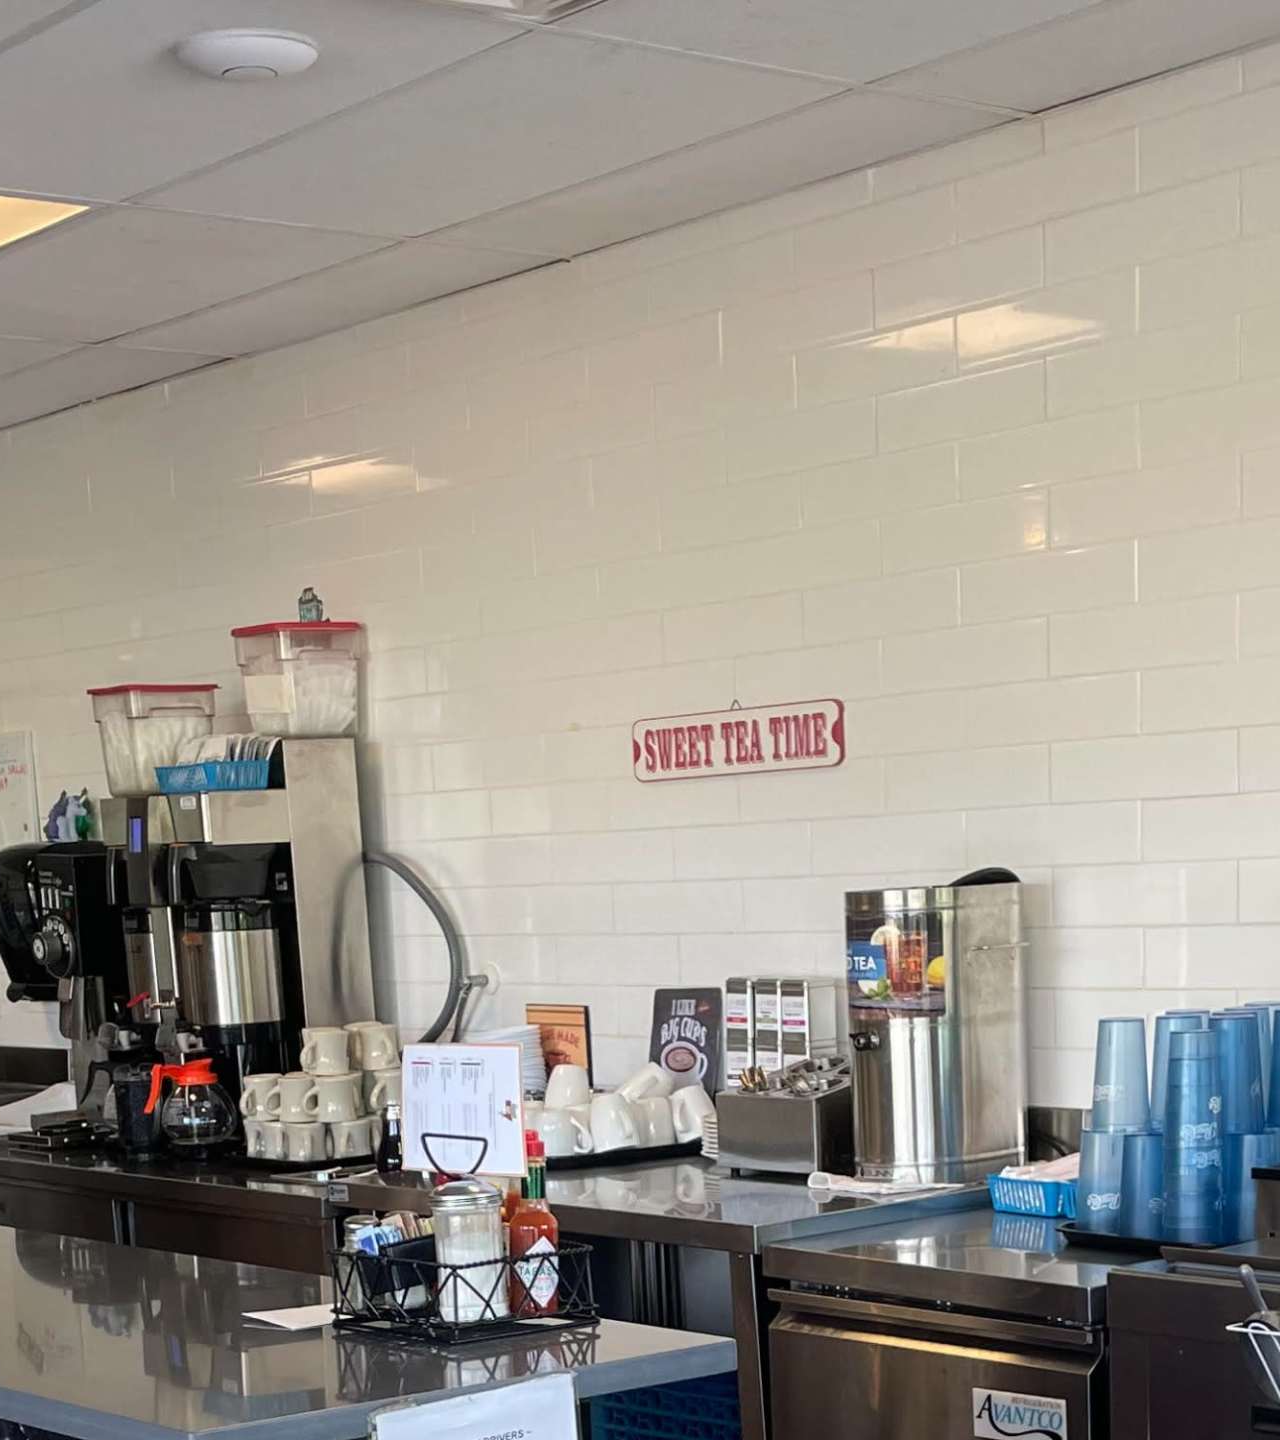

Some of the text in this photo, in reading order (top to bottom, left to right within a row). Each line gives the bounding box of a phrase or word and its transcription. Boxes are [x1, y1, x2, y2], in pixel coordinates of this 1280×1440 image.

[643, 711, 828, 774] SWEET TEA TIME
[853, 956, 877, 971] TEA
[660, 1016, 708, 1048] BIG CUPS
[975, 1393, 1064, 1434] AVANTCO
